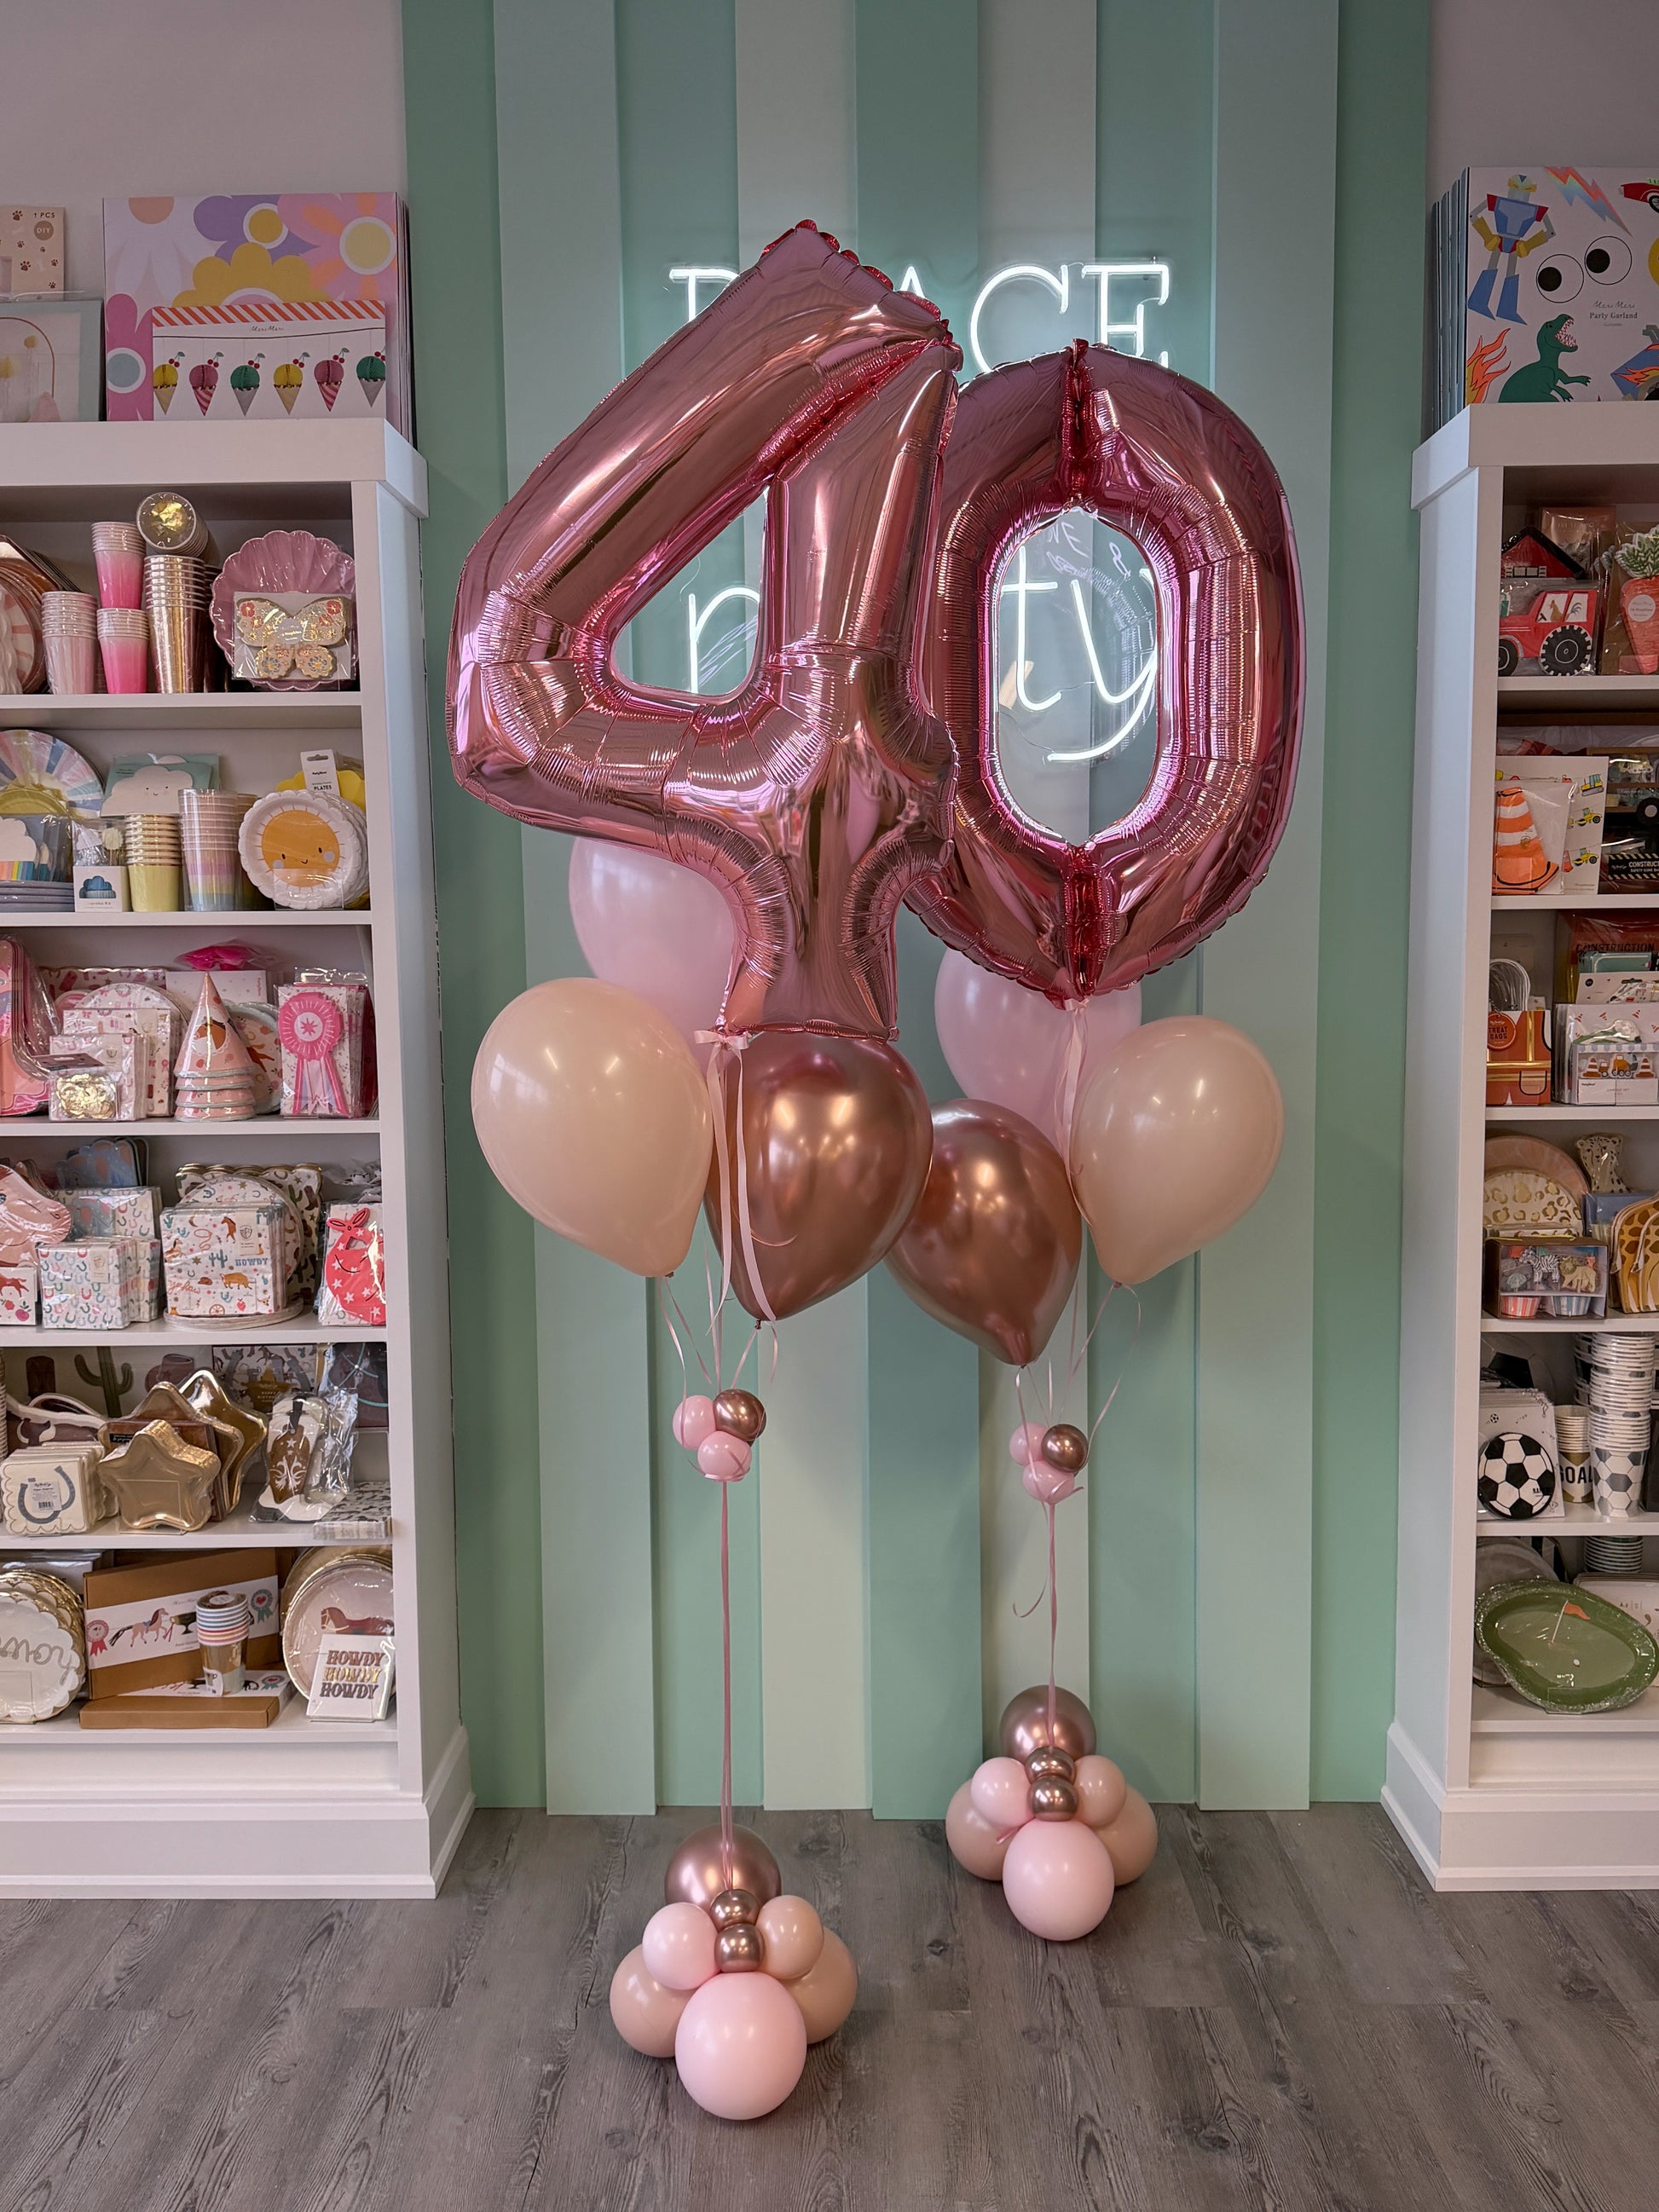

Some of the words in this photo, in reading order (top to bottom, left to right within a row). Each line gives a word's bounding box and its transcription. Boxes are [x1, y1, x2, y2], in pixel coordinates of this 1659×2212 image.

[1589, 312, 1609, 321] Party
[235, 1257, 269, 1267] HOWDY
[327, 1649, 386, 1667] HOWDY
[323, 1666, 383, 1684] HOWDY
[319, 1682, 379, 1700] HOWDY
